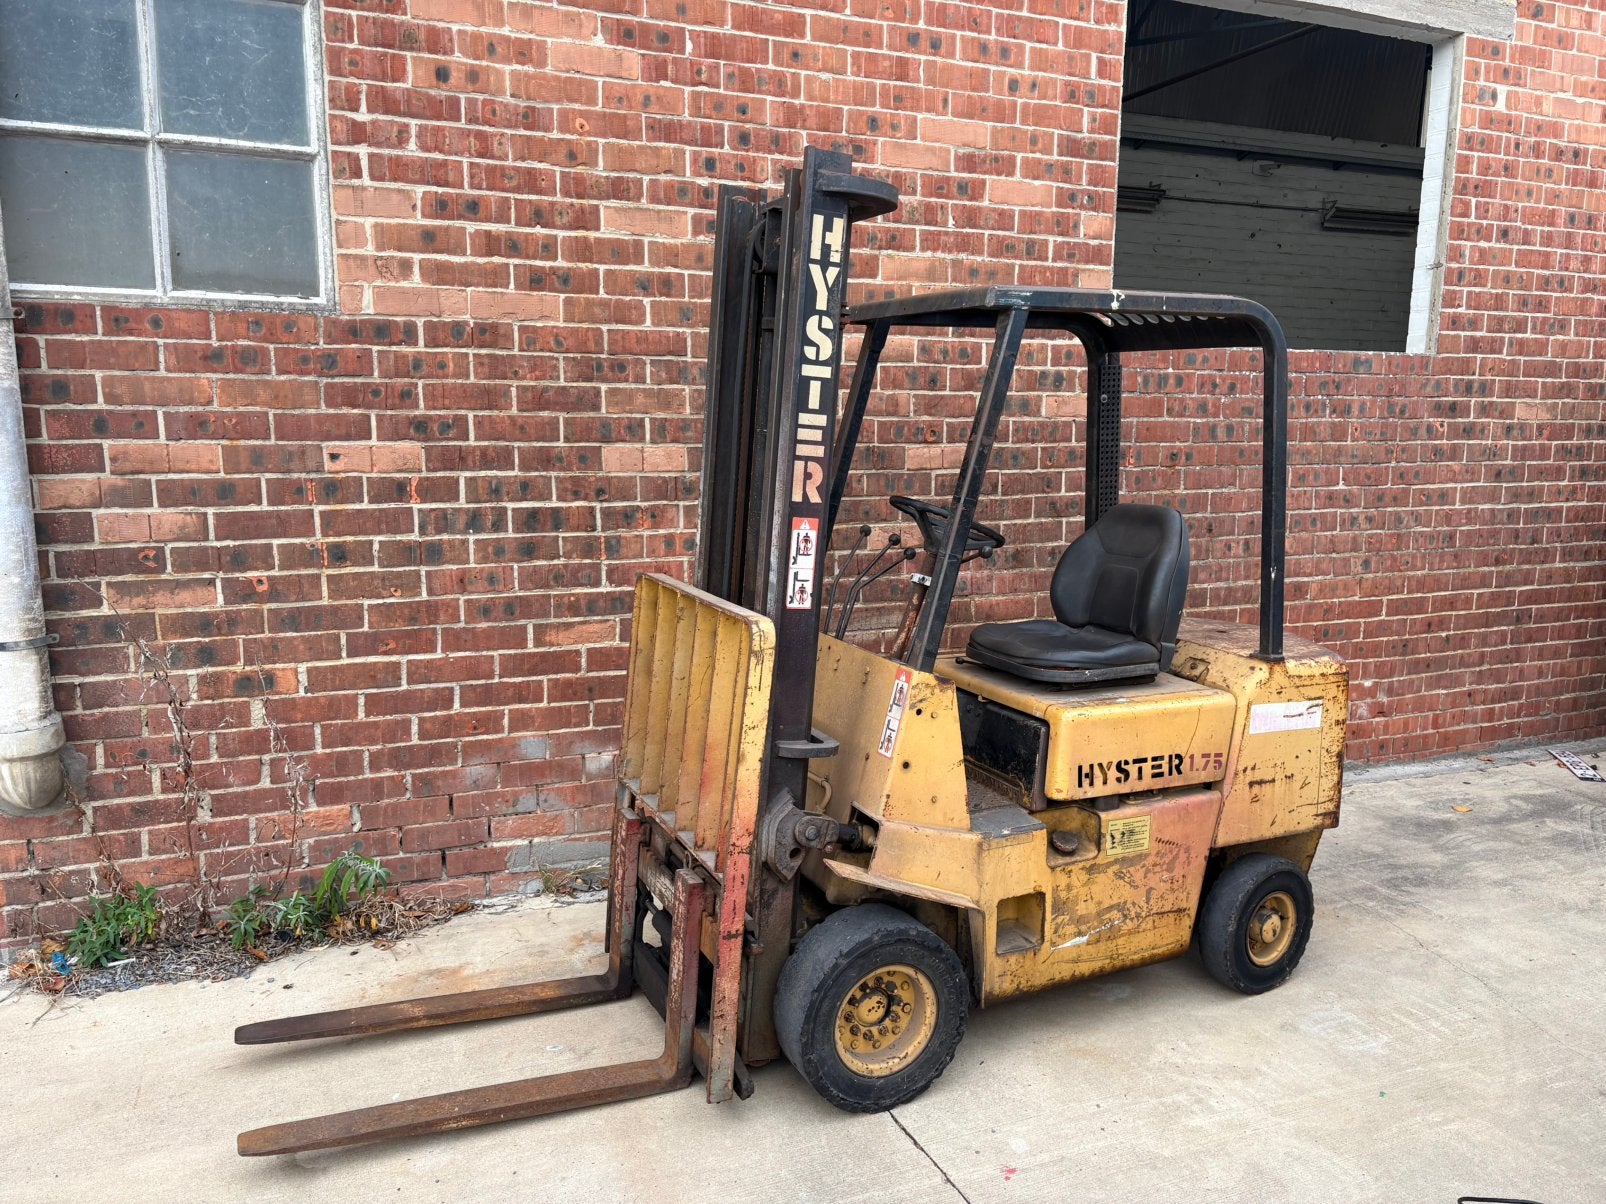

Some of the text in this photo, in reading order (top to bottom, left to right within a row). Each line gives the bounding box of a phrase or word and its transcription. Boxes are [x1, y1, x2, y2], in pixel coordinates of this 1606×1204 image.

[792, 214, 844, 503] HYSTER
[1077, 752, 1223, 788] HYSTER 1.75
